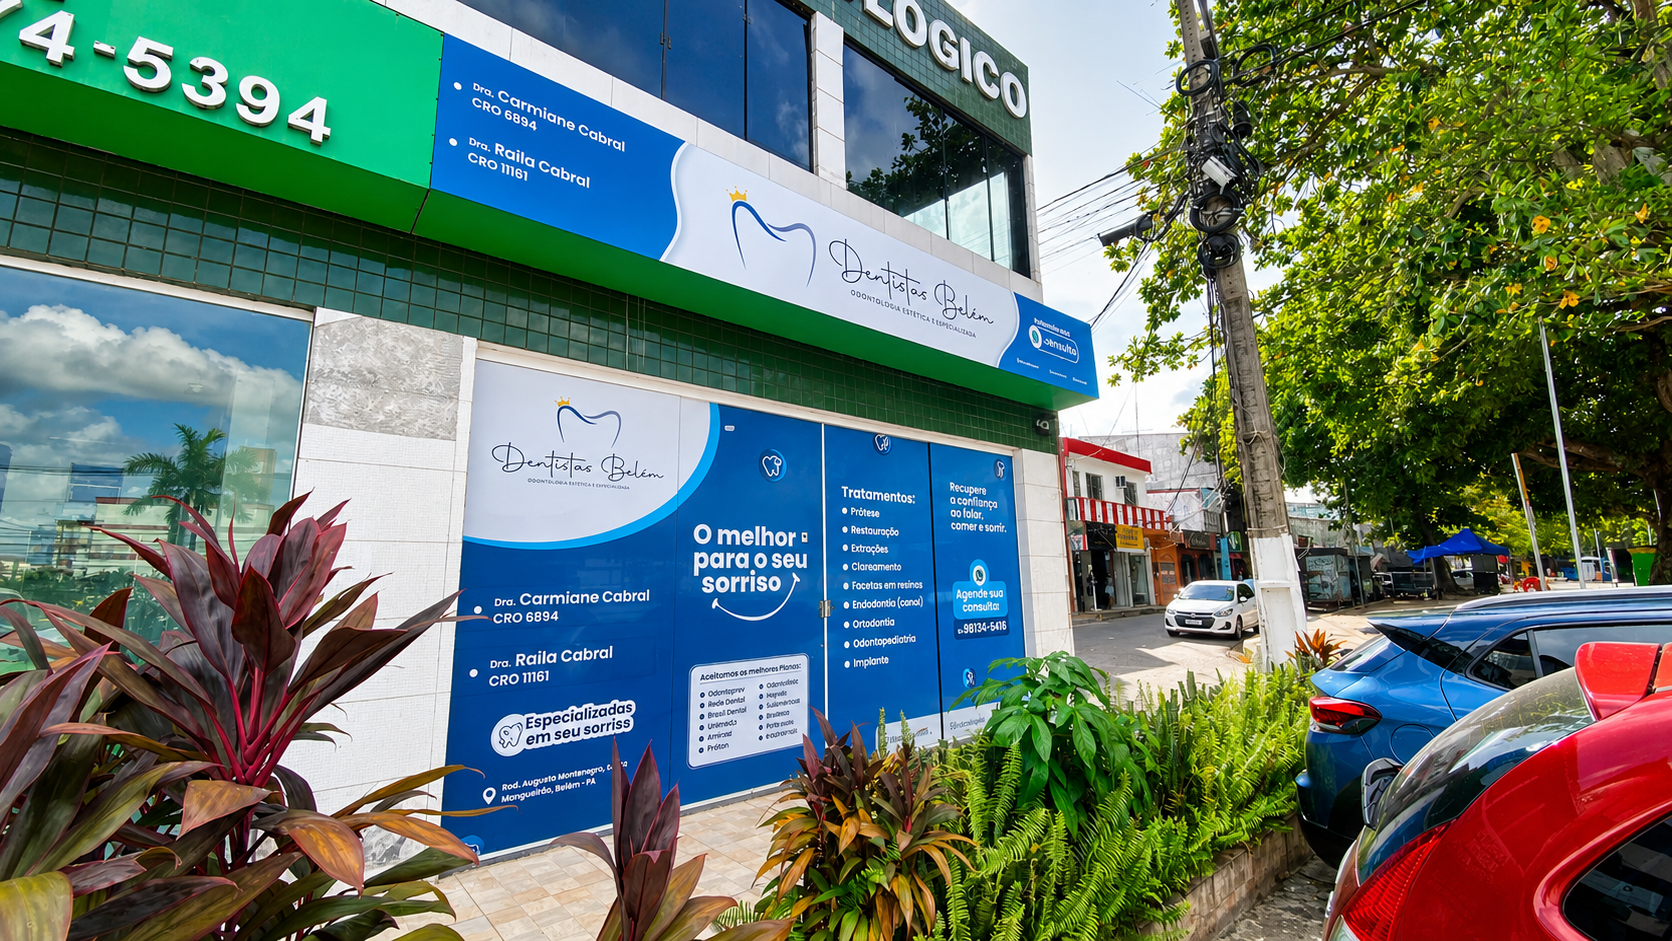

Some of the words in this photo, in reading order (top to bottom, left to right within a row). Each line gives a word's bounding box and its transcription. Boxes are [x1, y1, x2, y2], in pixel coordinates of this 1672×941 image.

[0, 0, 331, 146] 4-5394
[472, 98, 501, 116] CRO
[504, 110, 538, 131] 6894
[472, 82, 494, 98] Dra.
[498, 90, 576, 131] Carmiane
[578, 124, 626, 152] Cabral
[468, 152, 498, 170] CRO
[500, 162, 528, 182] 11161
[469, 137, 491, 152] Dra.
[494, 142, 536, 168] Raila
[538, 160, 590, 188] Cabral
[828, 238, 928, 306] Dentistas
[934, 280, 994, 325] Belém
[850, 289, 901, 312] ODONTOLOGIA
[492, 442, 592, 478] Dentistas
[600, 453, 664, 482] Belém
[841, 486, 916, 504] Tratamentos:
[950, 482, 987, 496] Recupere
[950, 510, 961, 518] ao
[693, 523, 712, 544] O
[717, 526, 796, 546] melhor
[951, 522, 977, 532] comer
[693, 552, 749, 576] para
[754, 553, 768, 569] o
[771, 553, 808, 569] seu
[852, 562, 902, 572] Clareamento
[702, 569, 781, 593] sorriso
[852, 581, 882, 590] Facetas
[494, 598, 516, 607] Dra.
[519, 591, 599, 606] Carmiane
[602, 589, 650, 603] Cabral
[852, 598, 896, 609] Endodontia
[956, 589, 988, 602] Agende
[989, 590, 1004, 598] sua
[493, 612, 522, 624] CRO
[526, 611, 559, 623] 6894
[853, 617, 895, 628] Ortodontia
[853, 634, 916, 648] Odontopediatria
[490, 660, 512, 669] Dra.
[515, 650, 557, 667] Raila
[560, 646, 613, 663] Cabral
[854, 656, 889, 669] Implante
[488, 673, 519, 687] CRO
[522, 670, 549, 684] 11161
[700, 671, 738, 681] Aceitamos
[748, 666, 778, 675] melhores
[525, 703, 632, 730] Especializadas
[526, 732, 551, 746] em
[554, 726, 581, 740] seu
[583, 717, 631, 735] sorriss
[502, 781, 521, 791] Rod.
[522, 775, 556, 787] Augusto
[558, 766, 605, 781] Montenegro,
[586, 778, 596, 786] PA
